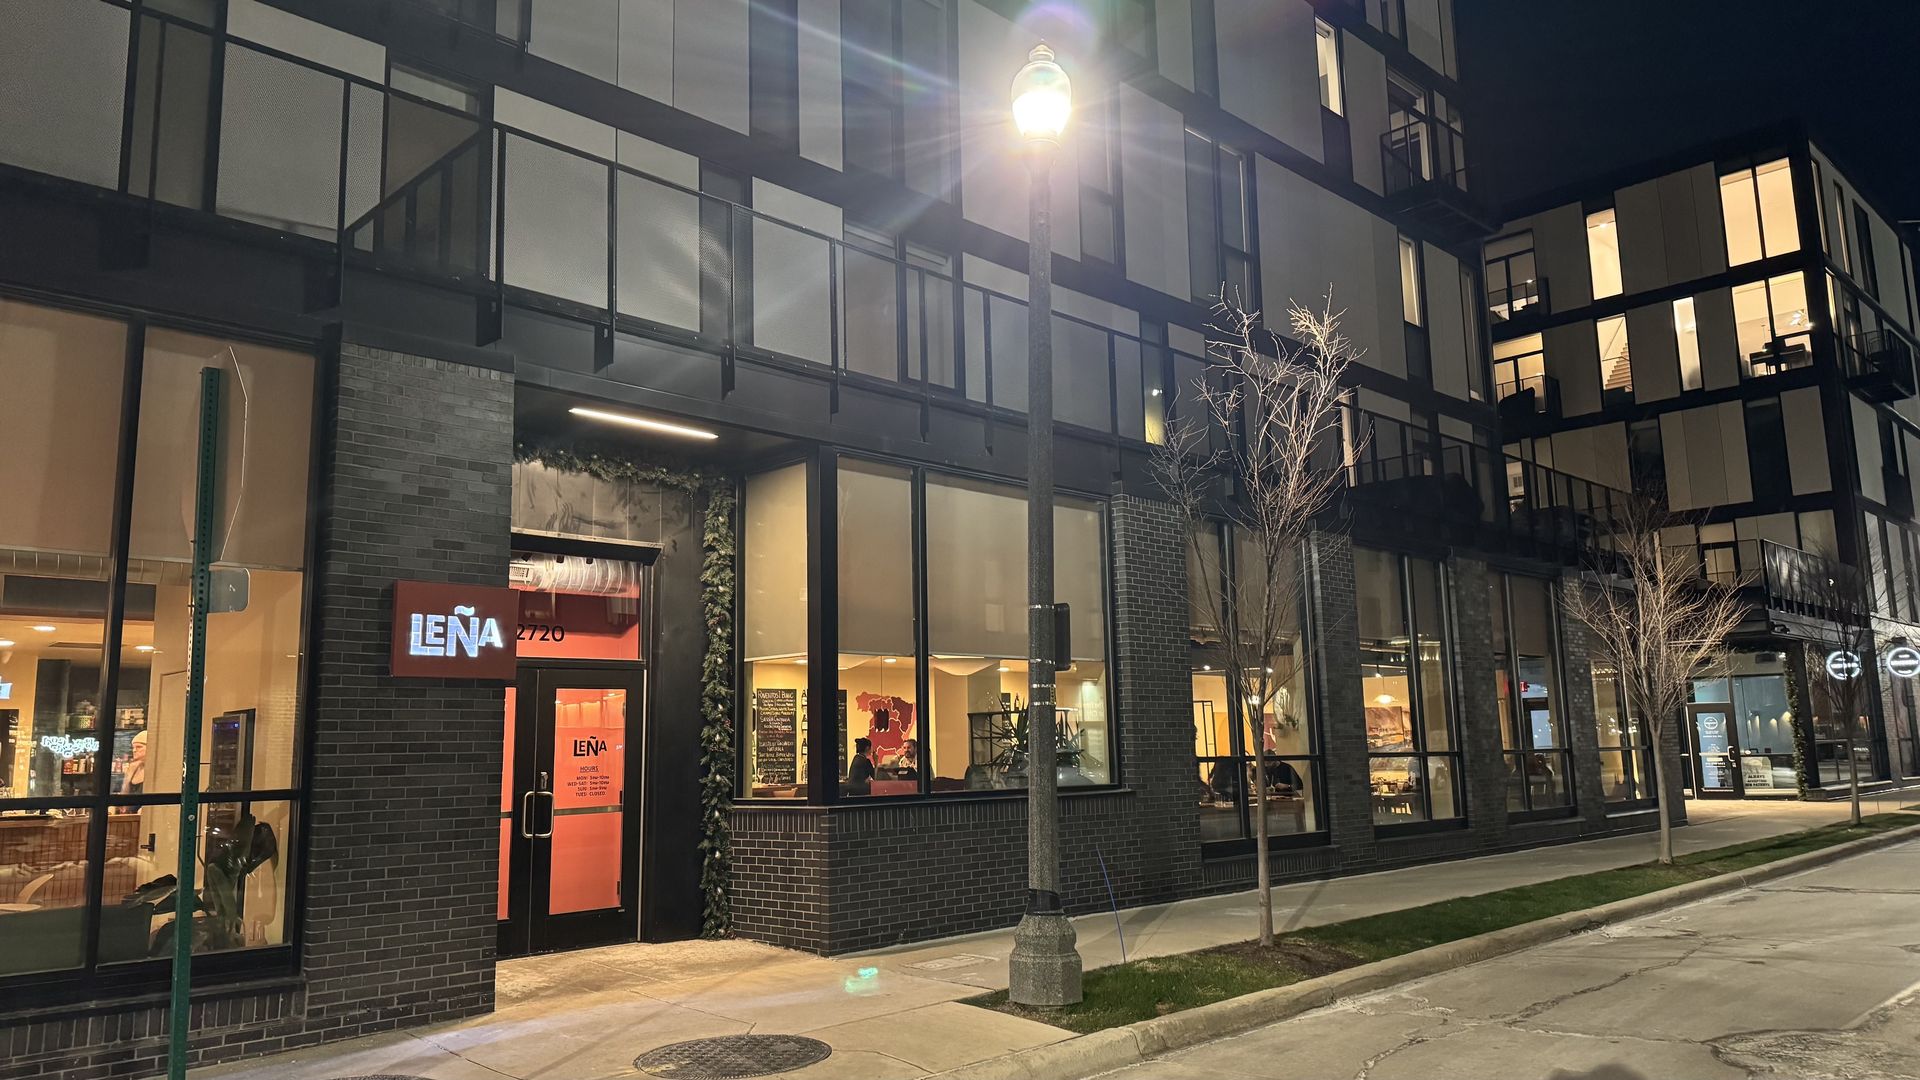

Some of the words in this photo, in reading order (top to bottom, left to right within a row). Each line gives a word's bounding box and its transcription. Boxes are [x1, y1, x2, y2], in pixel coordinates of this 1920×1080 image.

[409, 605, 503, 658] LEÑA
[516, 623, 566, 643] 2720
[573, 735, 608, 757] LEÑA
[579, 765, 600, 773] HOURS
